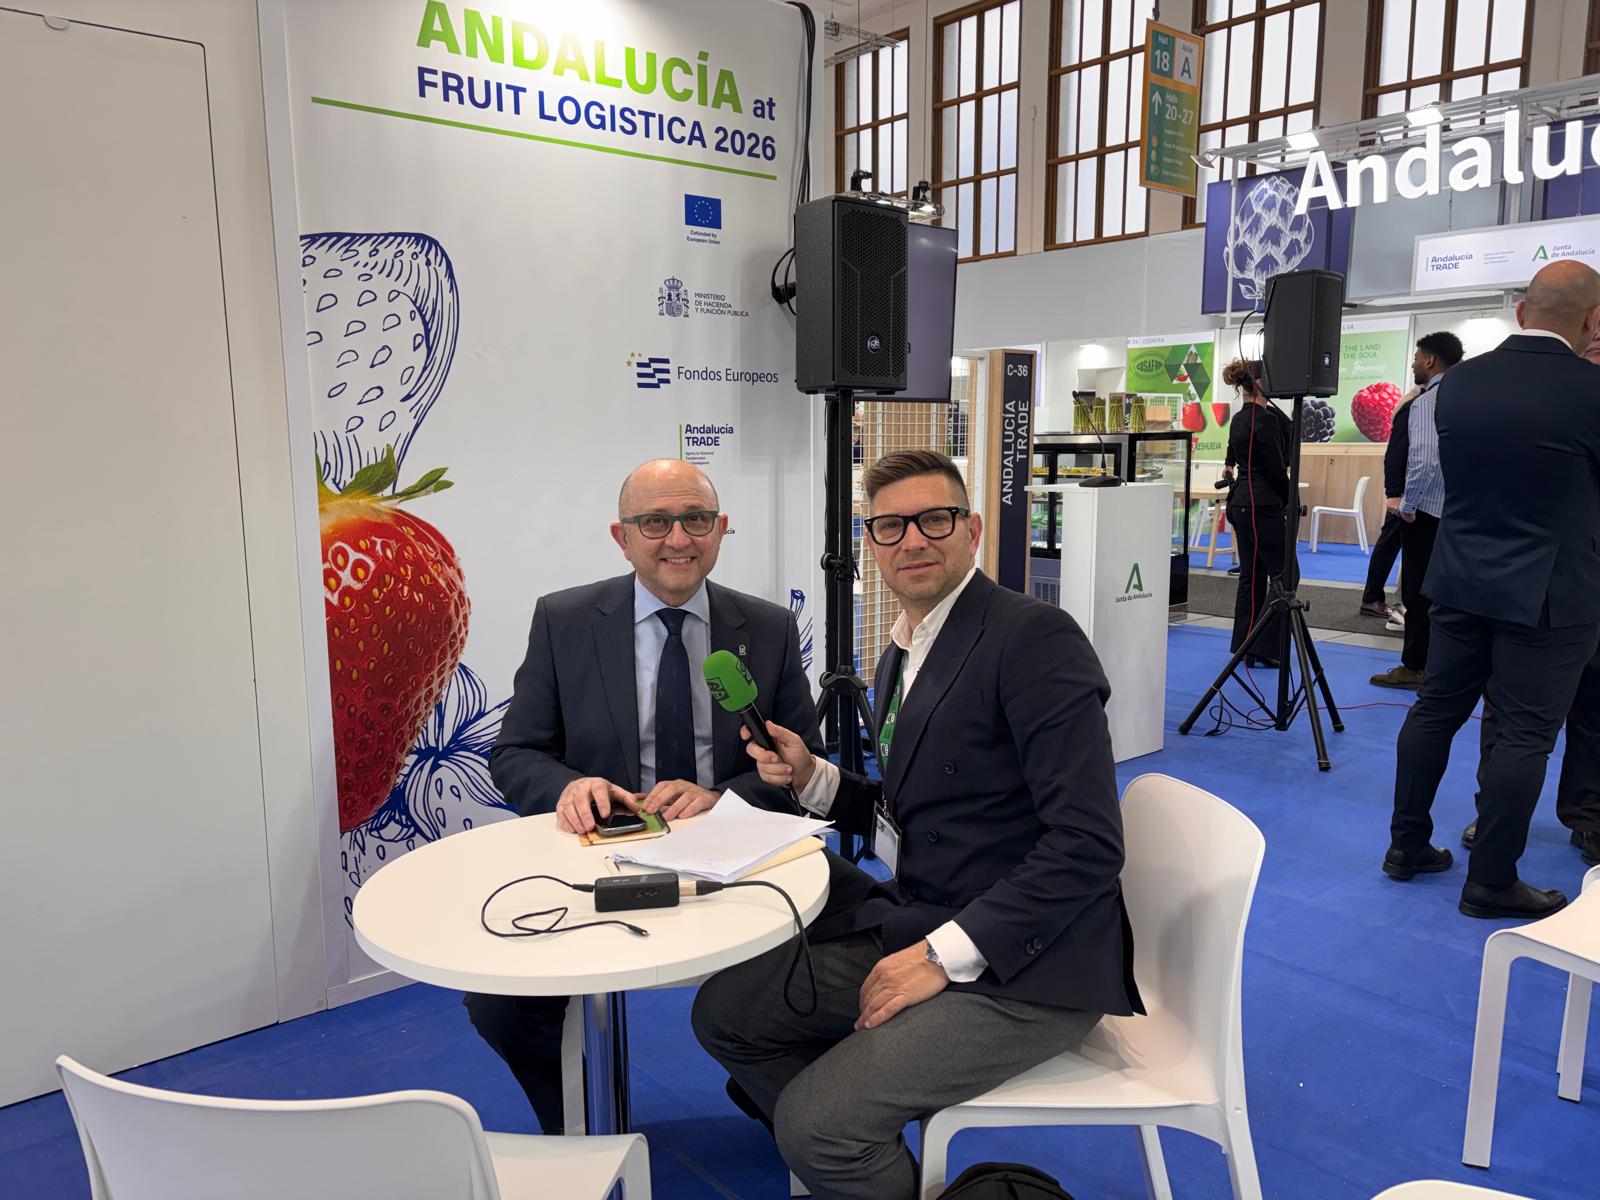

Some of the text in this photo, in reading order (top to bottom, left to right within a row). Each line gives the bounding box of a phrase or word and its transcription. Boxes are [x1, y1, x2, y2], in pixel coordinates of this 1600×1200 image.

[417, 0, 776, 121] ANDALUCÍA at
[1154, 49, 1170, 72] 18
[1181, 56, 1192, 80] A
[417, 66, 776, 162] FRUIT LOGISTICA 2026
[1293, 109, 1600, 217] Andalu
[1430, 262, 1460, 271] TRADE
[1431, 252, 1473, 263] Andalucía
[694, 292, 726, 301] MINISTERIO
[677, 365, 779, 386] Fondos Europeos
[1007, 363, 1028, 377] C-36
[685, 423, 734, 435] Andalucía
[1016, 400, 1029, 462] TRADE
[685, 436, 720, 447] TRADE
[1002, 400, 1017, 505] ANDALUCÍA
